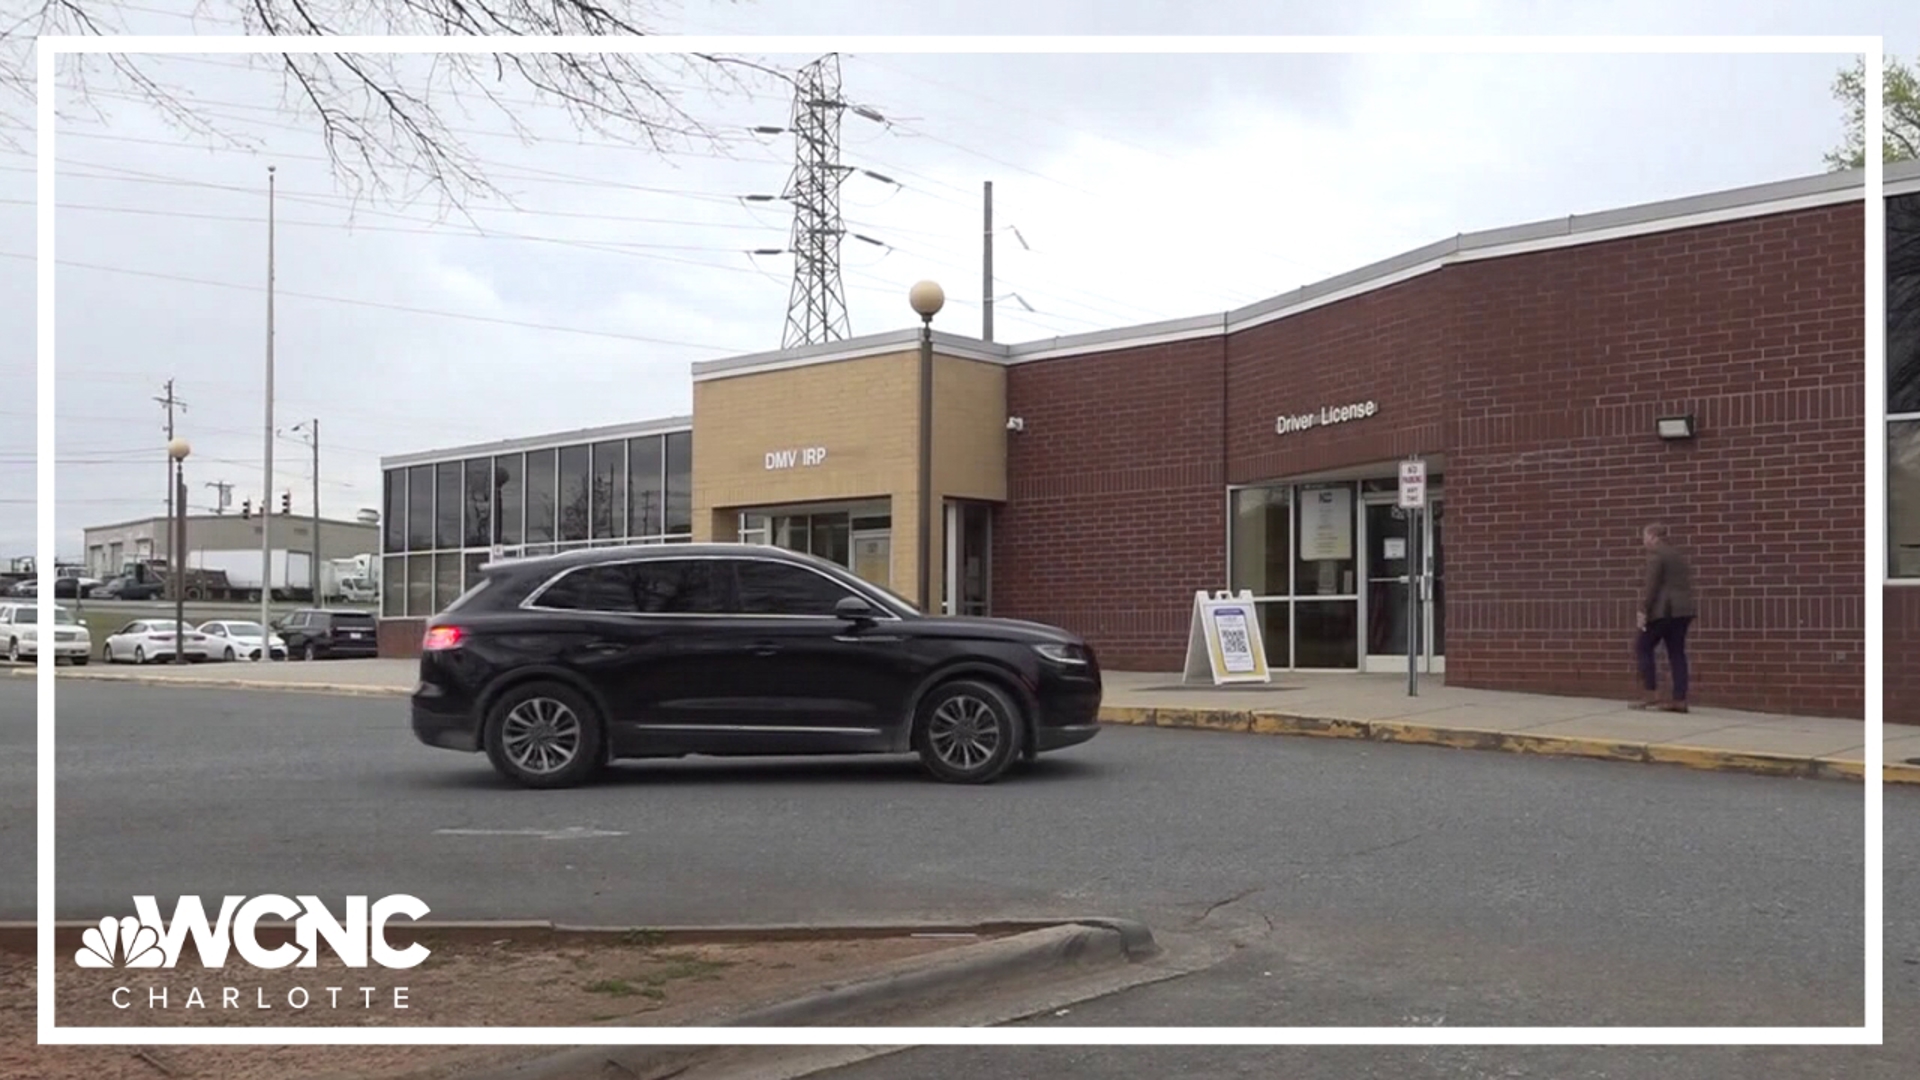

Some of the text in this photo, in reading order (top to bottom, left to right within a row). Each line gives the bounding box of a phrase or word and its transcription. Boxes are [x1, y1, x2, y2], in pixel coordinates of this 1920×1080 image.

[1277, 401, 1375, 434] Driver License
[765, 447, 826, 470] DMV IRP
